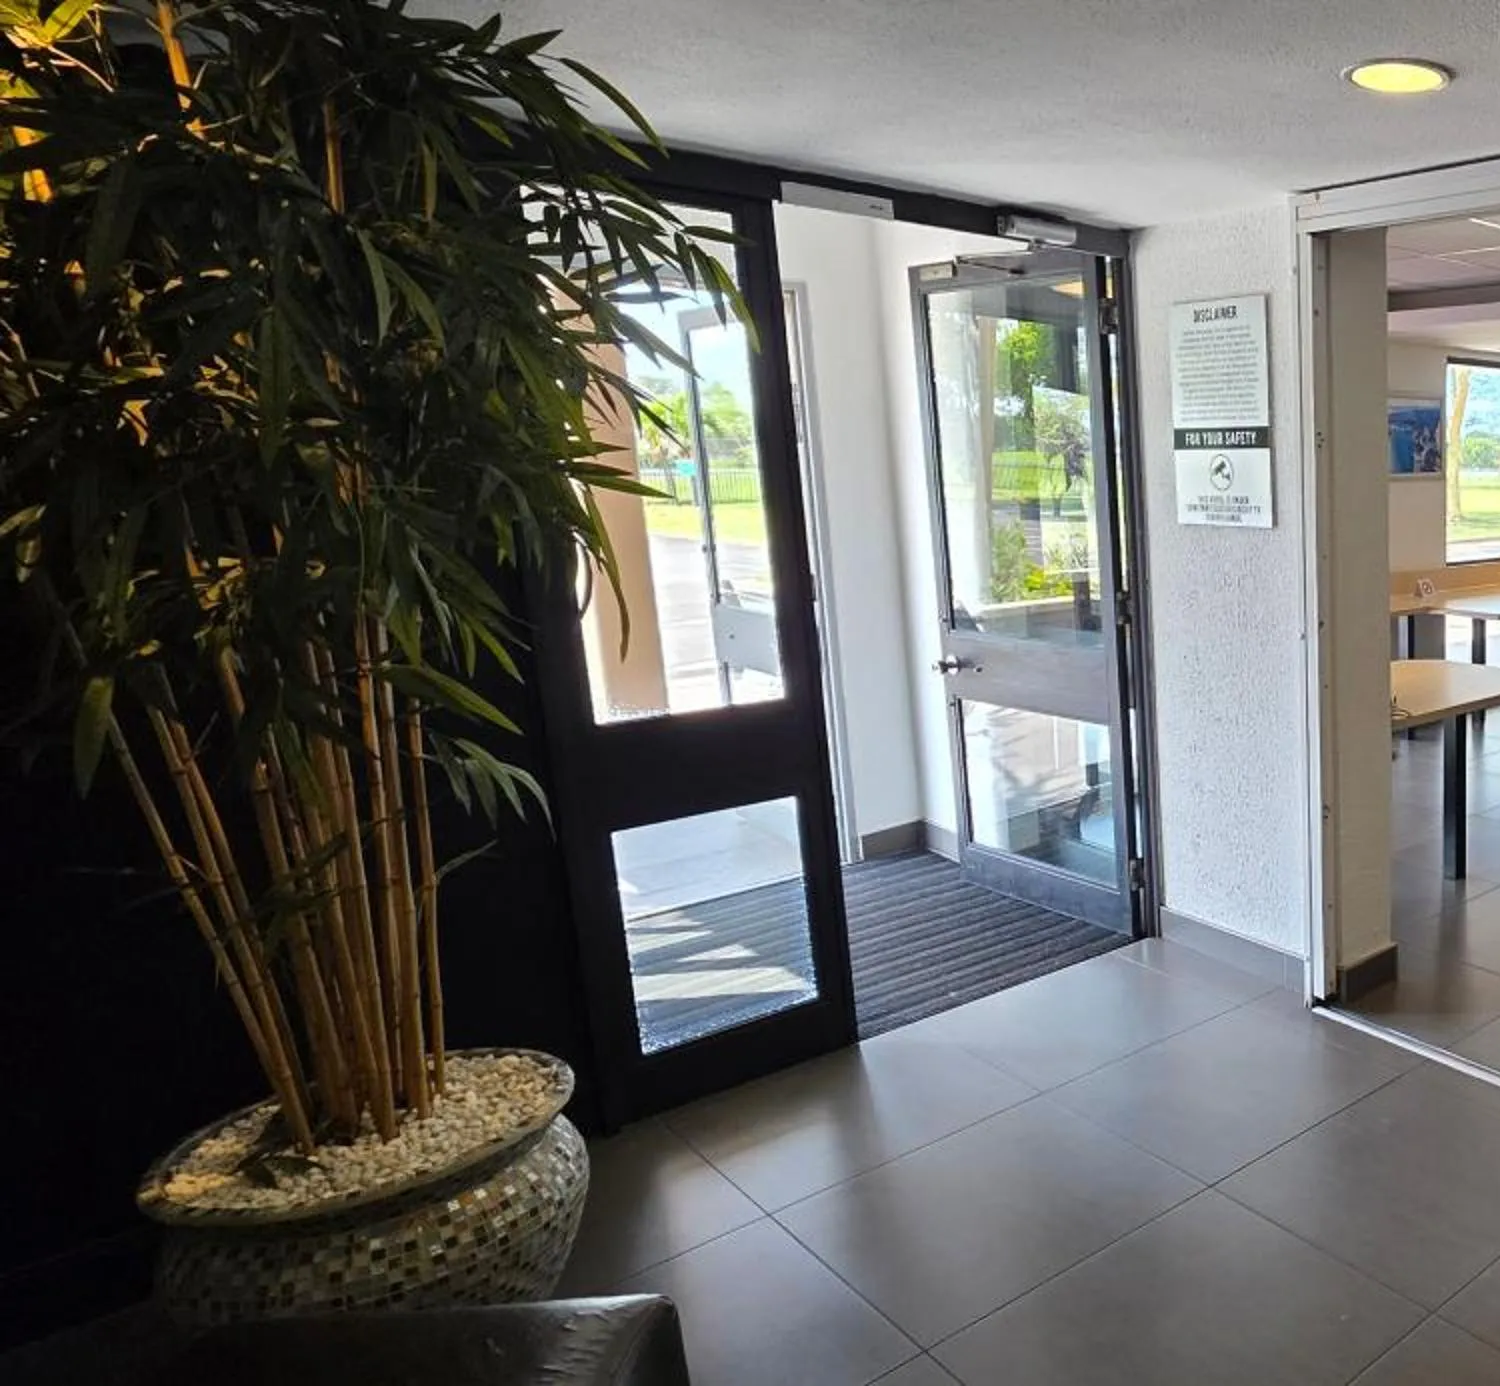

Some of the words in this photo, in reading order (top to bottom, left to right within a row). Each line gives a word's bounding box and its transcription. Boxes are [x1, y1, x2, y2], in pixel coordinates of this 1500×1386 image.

[1193, 305, 1237, 323] DISCLAIMER
[1185, 432, 1200, 446] FOR
[1202, 431, 1223, 446] YOUR
[1225, 431, 1257, 446] SAFETY
